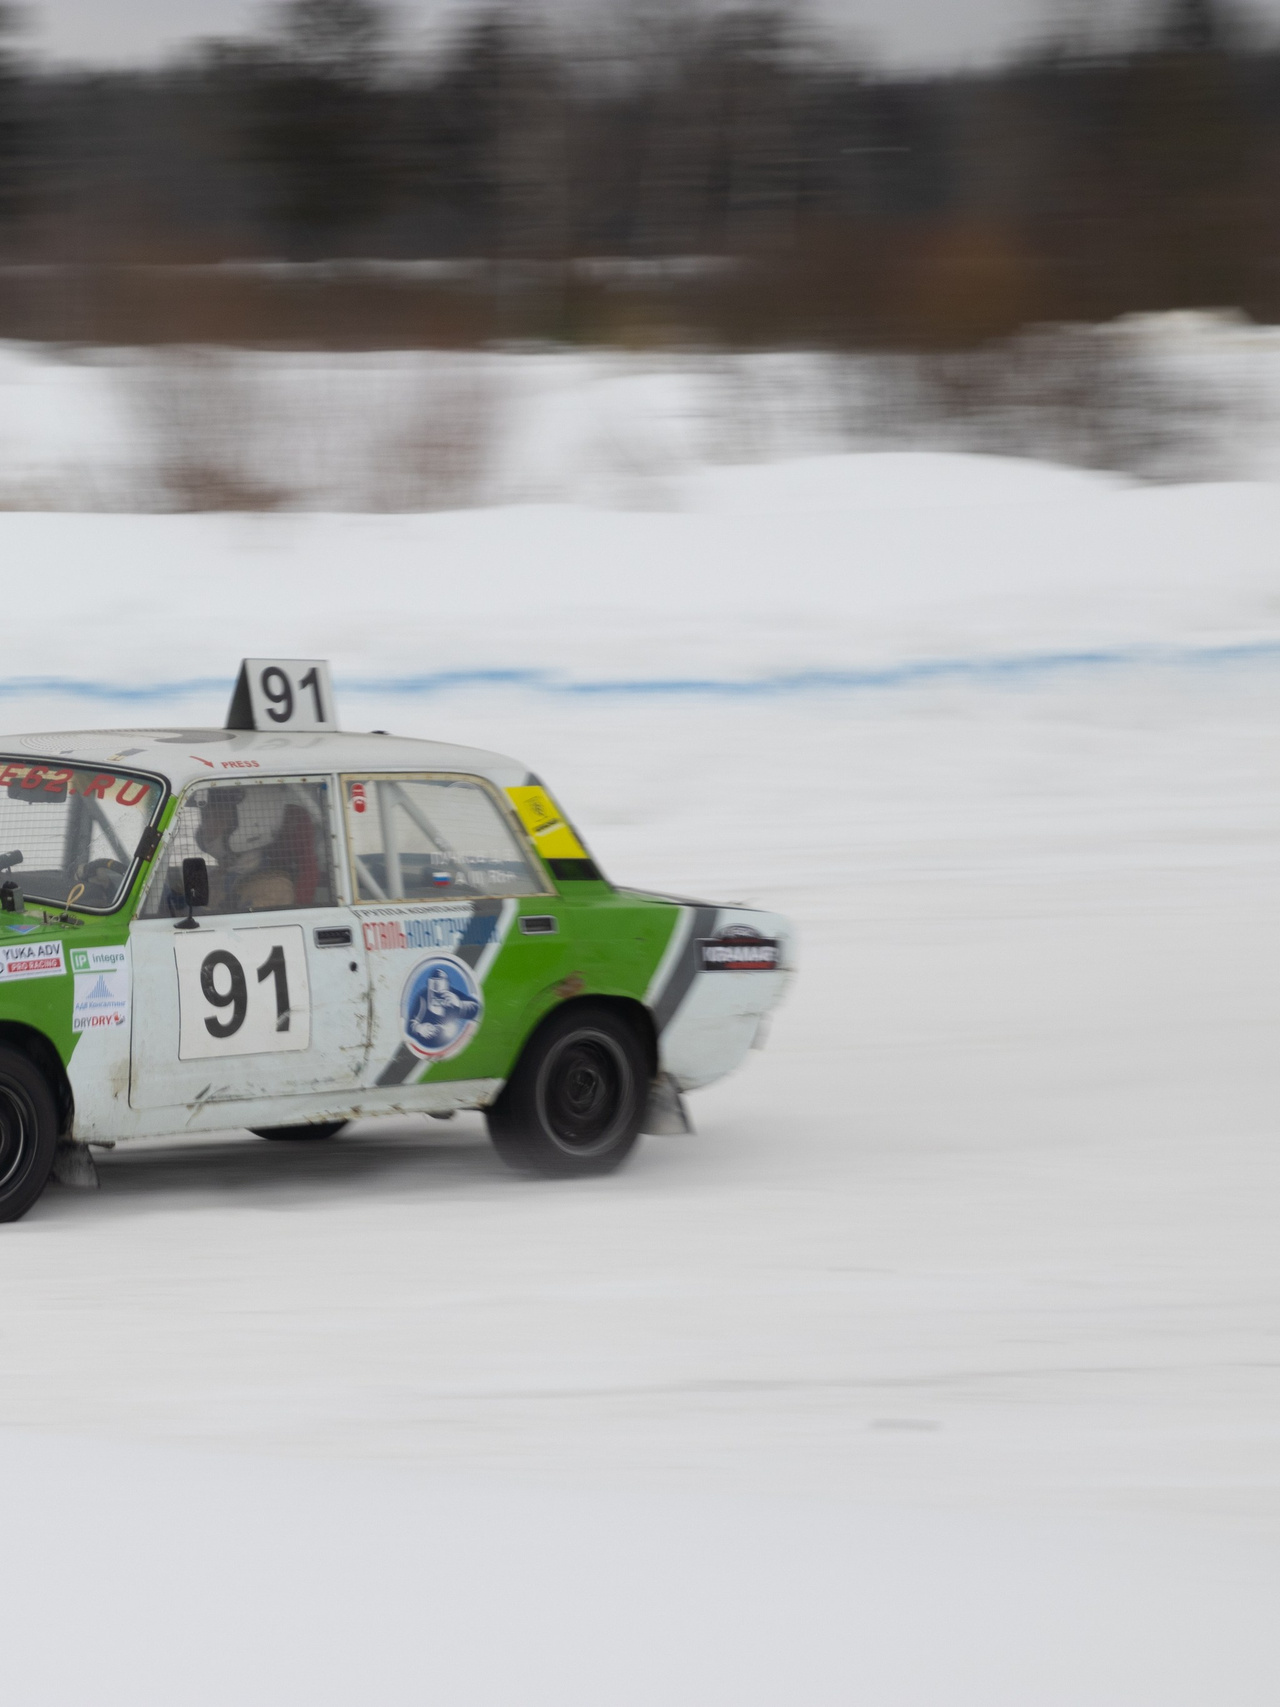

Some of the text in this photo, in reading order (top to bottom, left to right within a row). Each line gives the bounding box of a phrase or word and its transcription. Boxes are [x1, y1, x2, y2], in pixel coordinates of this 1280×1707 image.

[260, 666, 327, 724] 91
[221, 760, 260, 769] PRESS
[357, 908, 405, 919] ГРУППА
[2, 943, 61, 961] YUKA ADV
[92, 951, 125, 964] integra
[11, 958, 58, 972] PRO RACING
[200, 945, 290, 1038] 91
